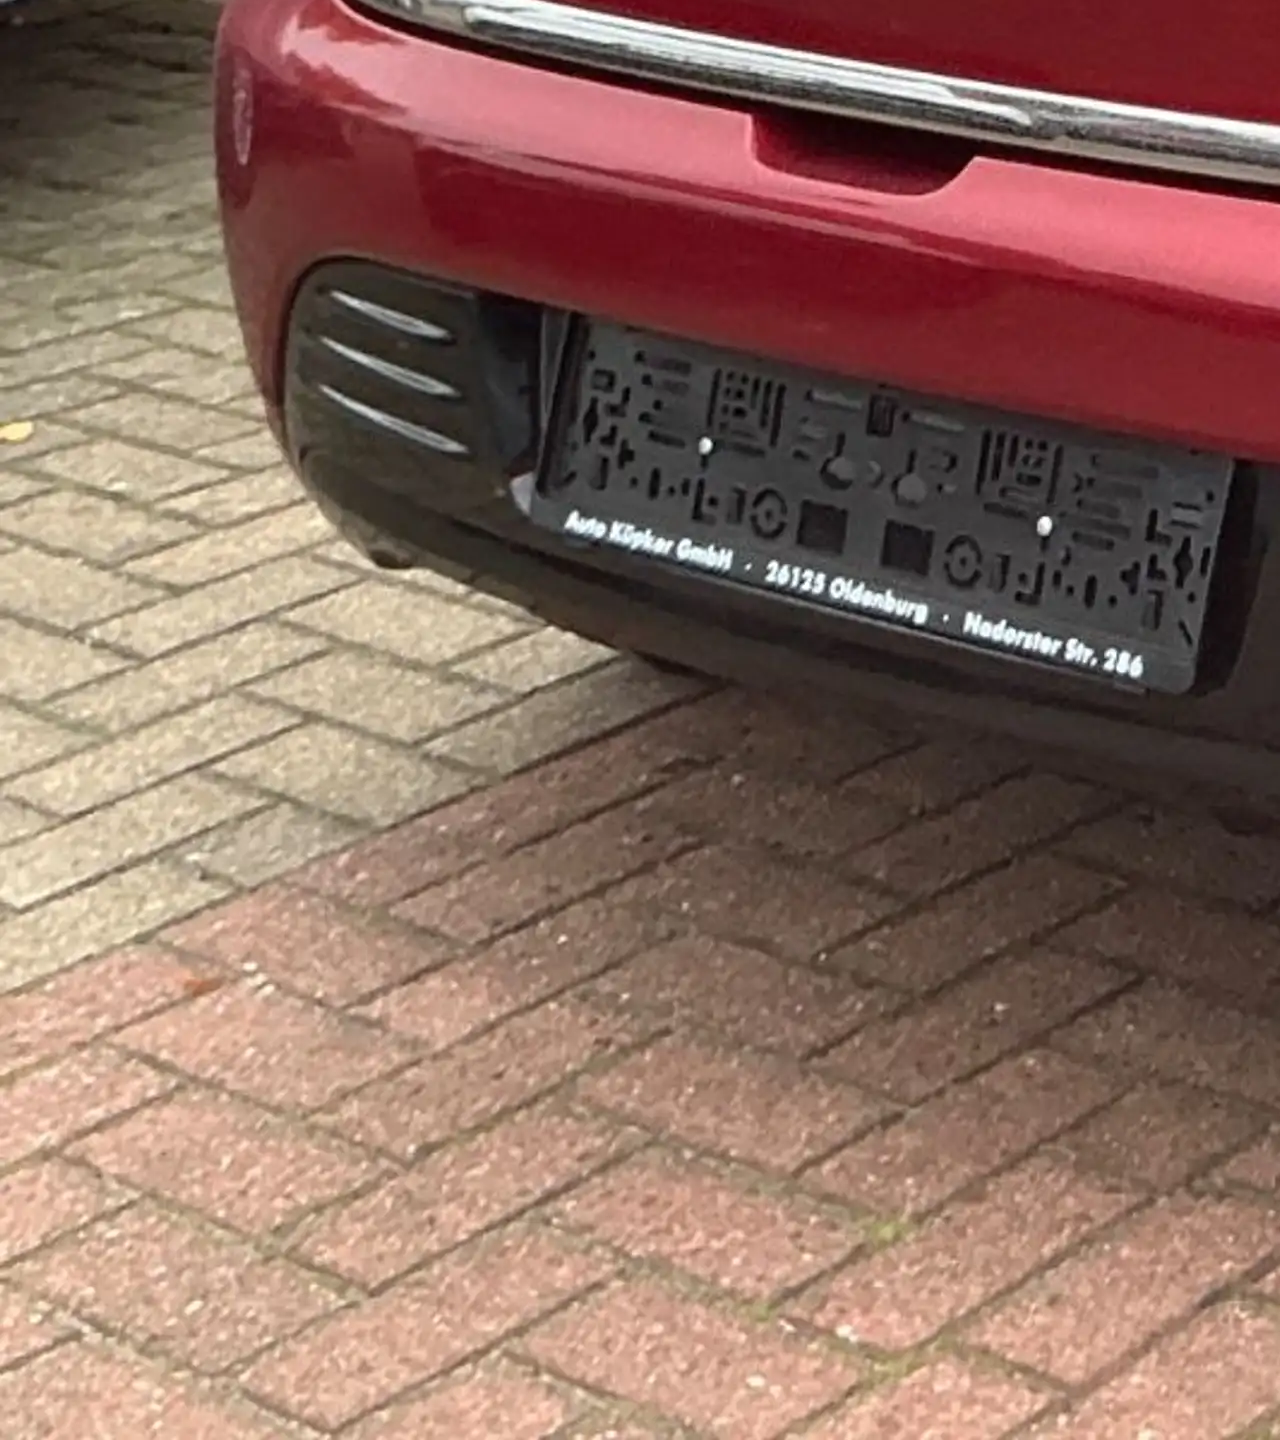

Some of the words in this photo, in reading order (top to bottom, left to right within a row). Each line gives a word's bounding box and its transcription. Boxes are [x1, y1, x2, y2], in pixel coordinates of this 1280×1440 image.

[564, 509, 607, 539] Auto
[675, 537, 735, 572] GmbH
[764, 559, 826, 595] 26125
[829, 572, 929, 626] Oldenburg
[962, 610, 1063, 657] Nadorster
[1063, 637, 1099, 668] Str.
[1102, 647, 1145, 680] 286
